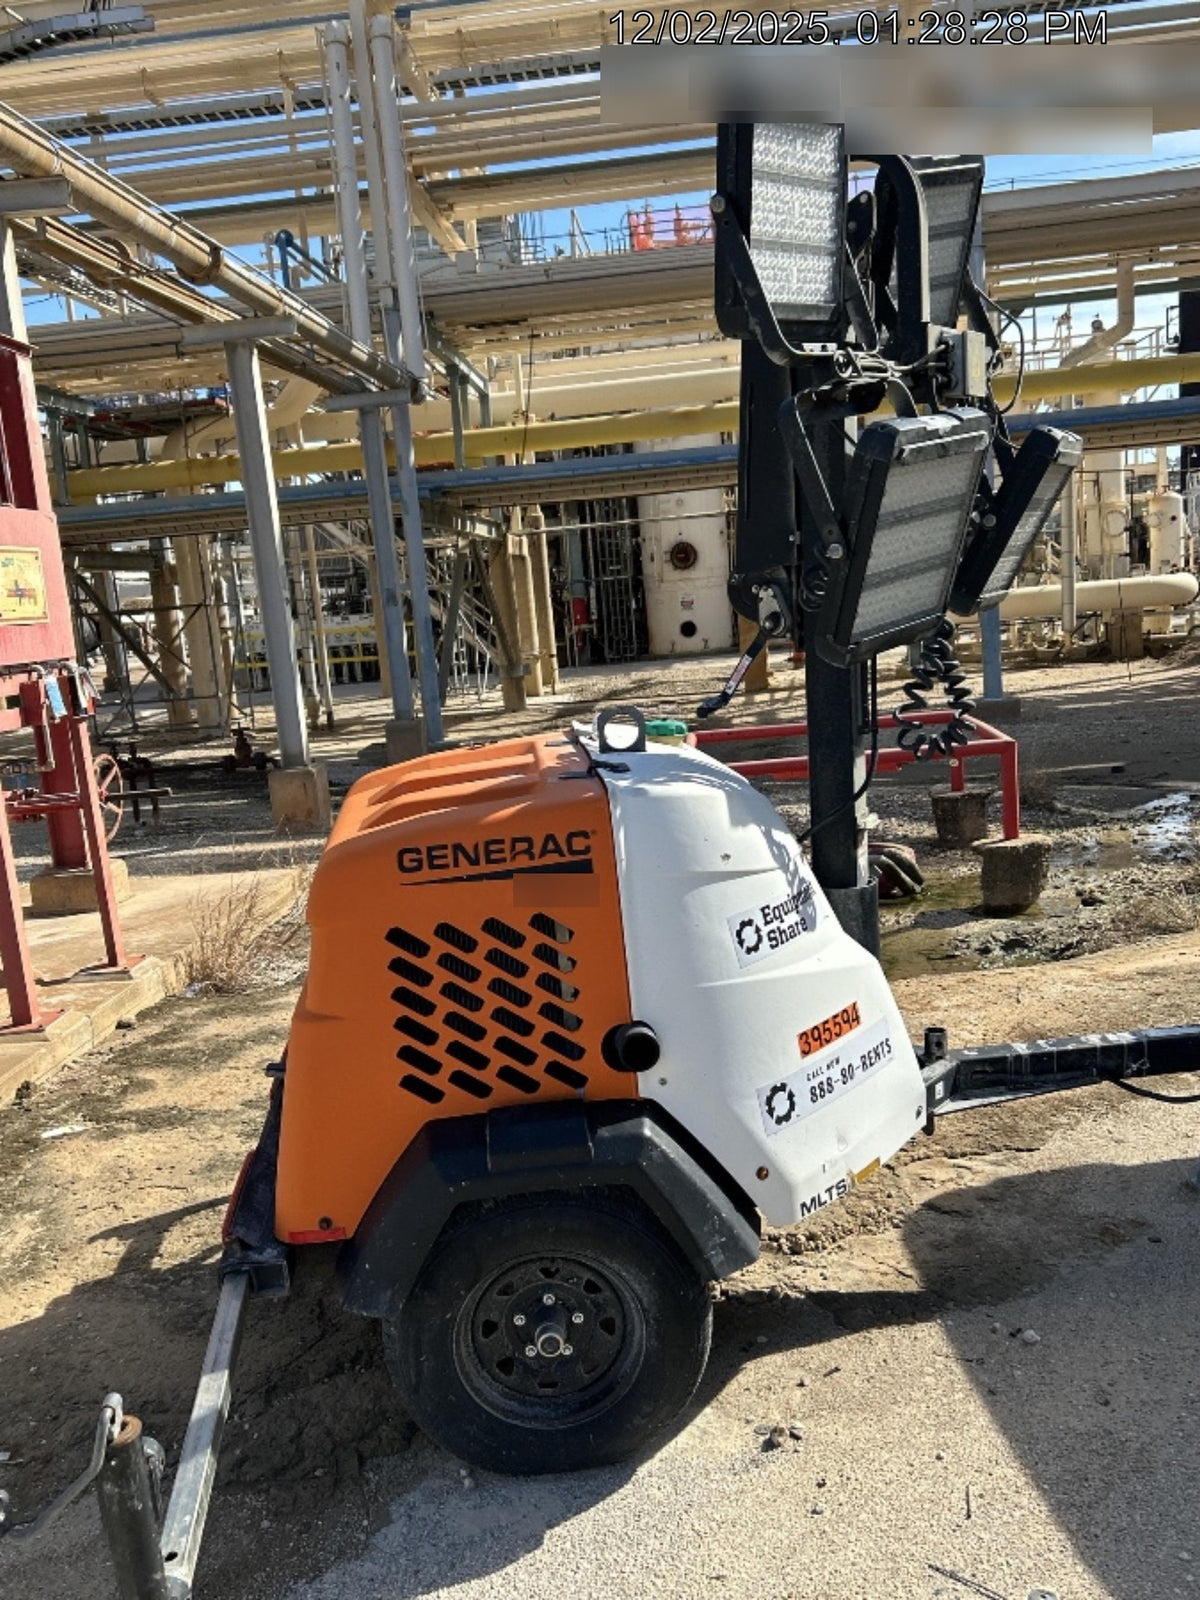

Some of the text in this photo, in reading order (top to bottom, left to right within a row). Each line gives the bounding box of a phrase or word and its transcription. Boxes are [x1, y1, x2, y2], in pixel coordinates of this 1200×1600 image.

[397, 830, 592, 873] GENERAC
[767, 917, 808, 950] Share
[799, 1001, 861, 1056] 395594
